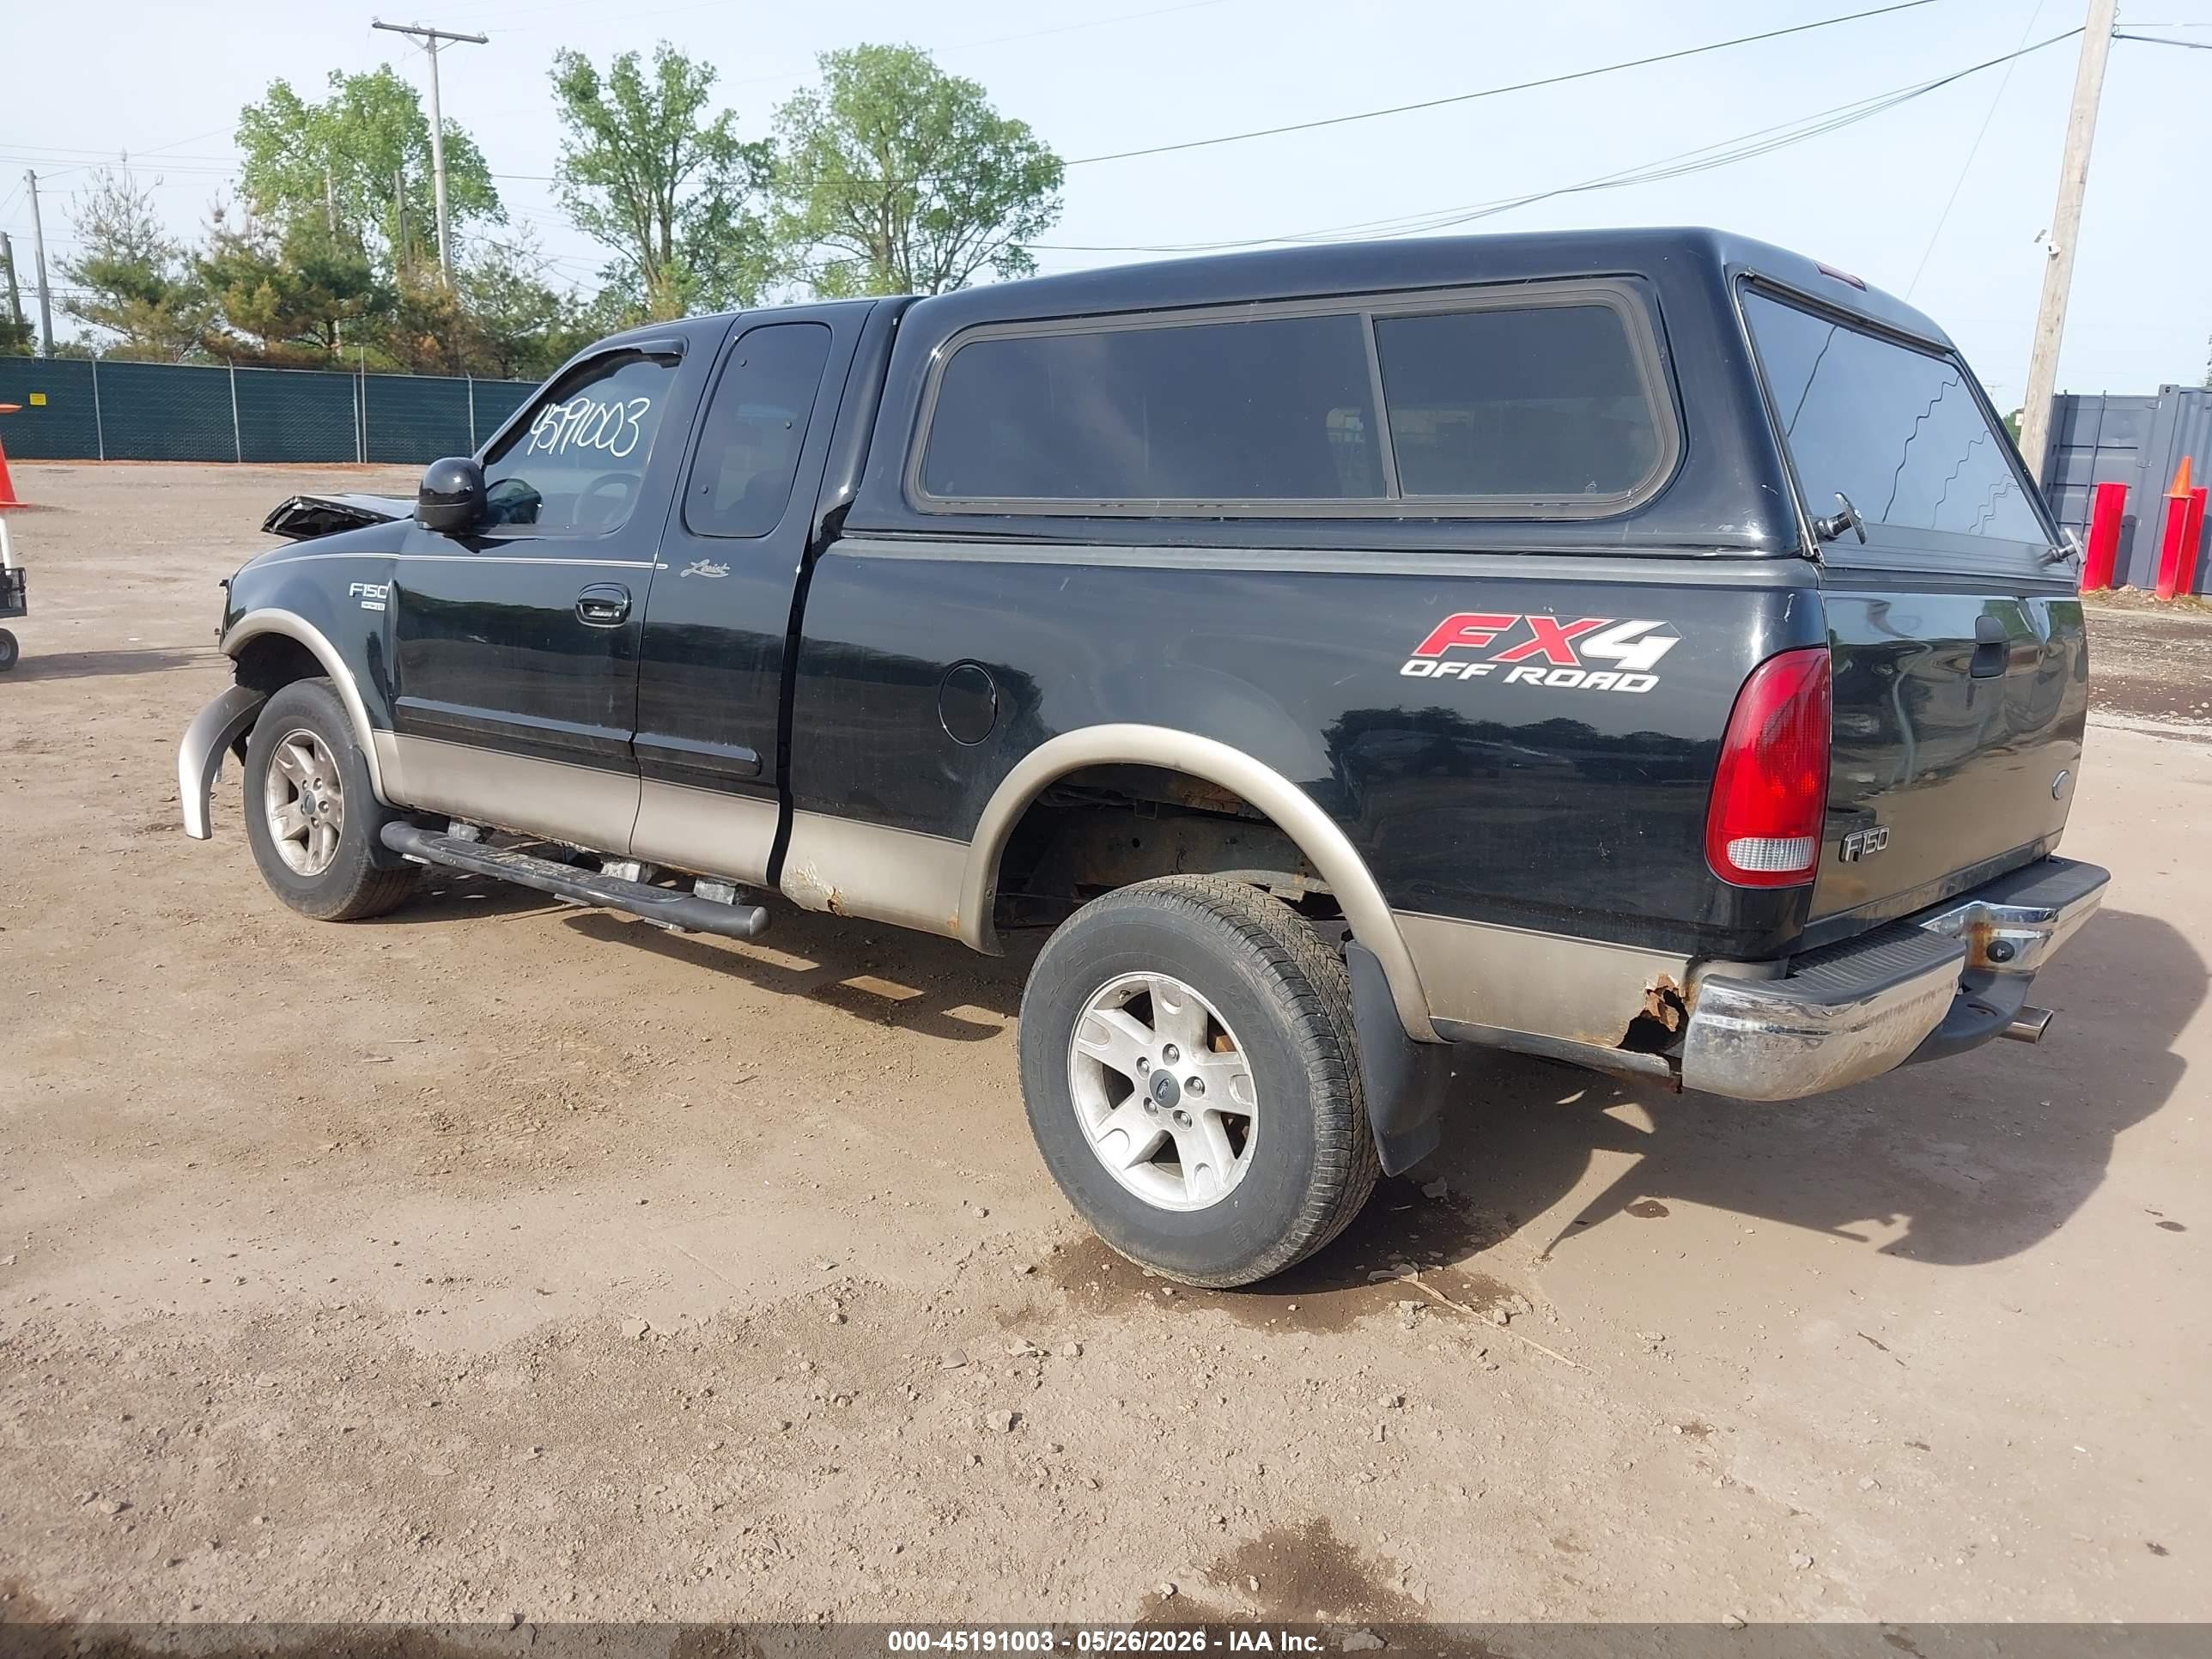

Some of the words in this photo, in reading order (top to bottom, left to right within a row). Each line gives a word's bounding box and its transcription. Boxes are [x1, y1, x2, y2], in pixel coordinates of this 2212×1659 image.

[1409, 611, 1683, 672] FX4
[1399, 659, 1497, 680] OFF
[1502, 665, 1661, 694] ROAD
